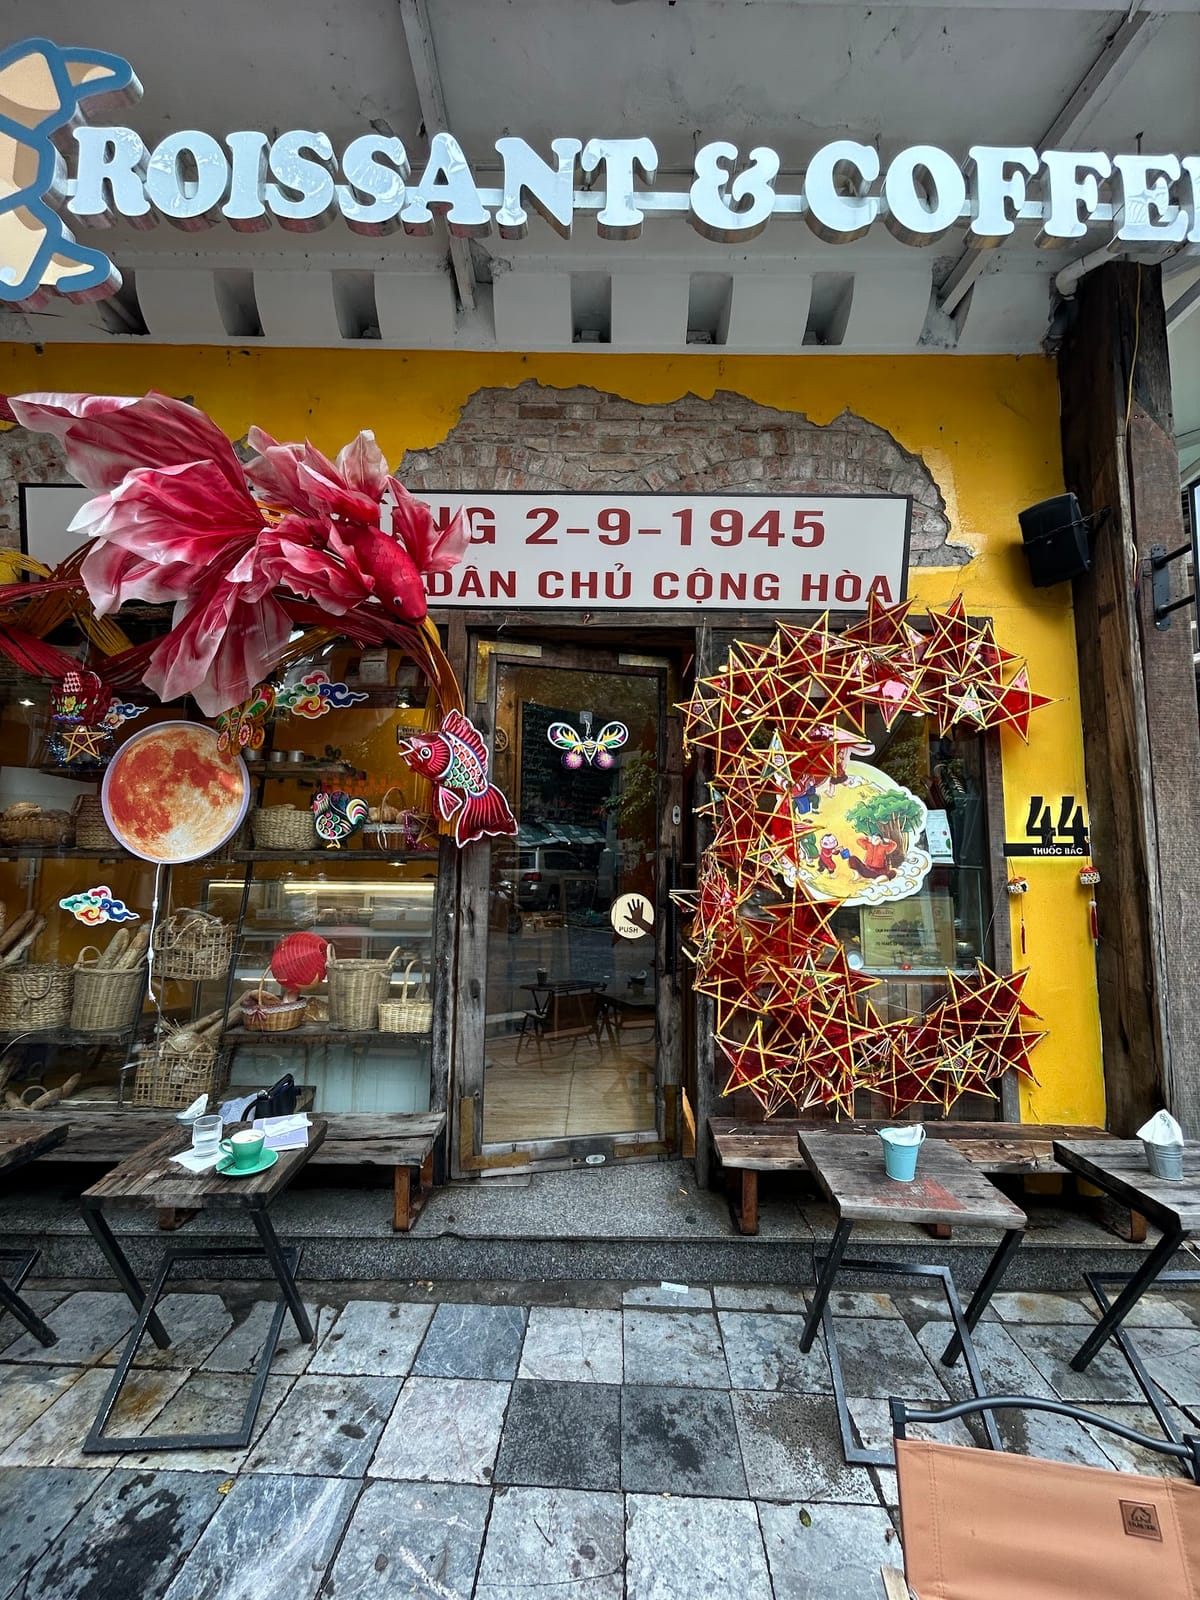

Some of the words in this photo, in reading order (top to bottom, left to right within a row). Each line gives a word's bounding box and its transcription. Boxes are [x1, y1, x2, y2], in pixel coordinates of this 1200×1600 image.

[690, 141, 780, 231] &
[804, 140, 1200, 242] COFFE
[525, 507, 825, 548] 2-9-1945
[425, 565, 516, 598] DÂN
[537, 562, 632, 600] CHỦ
[653, 567, 780, 604] CỘNG
[801, 569, 893, 603] HÒA
[1026, 796, 1088, 844] 44
[1032, 844, 1062, 855] THUỐC
